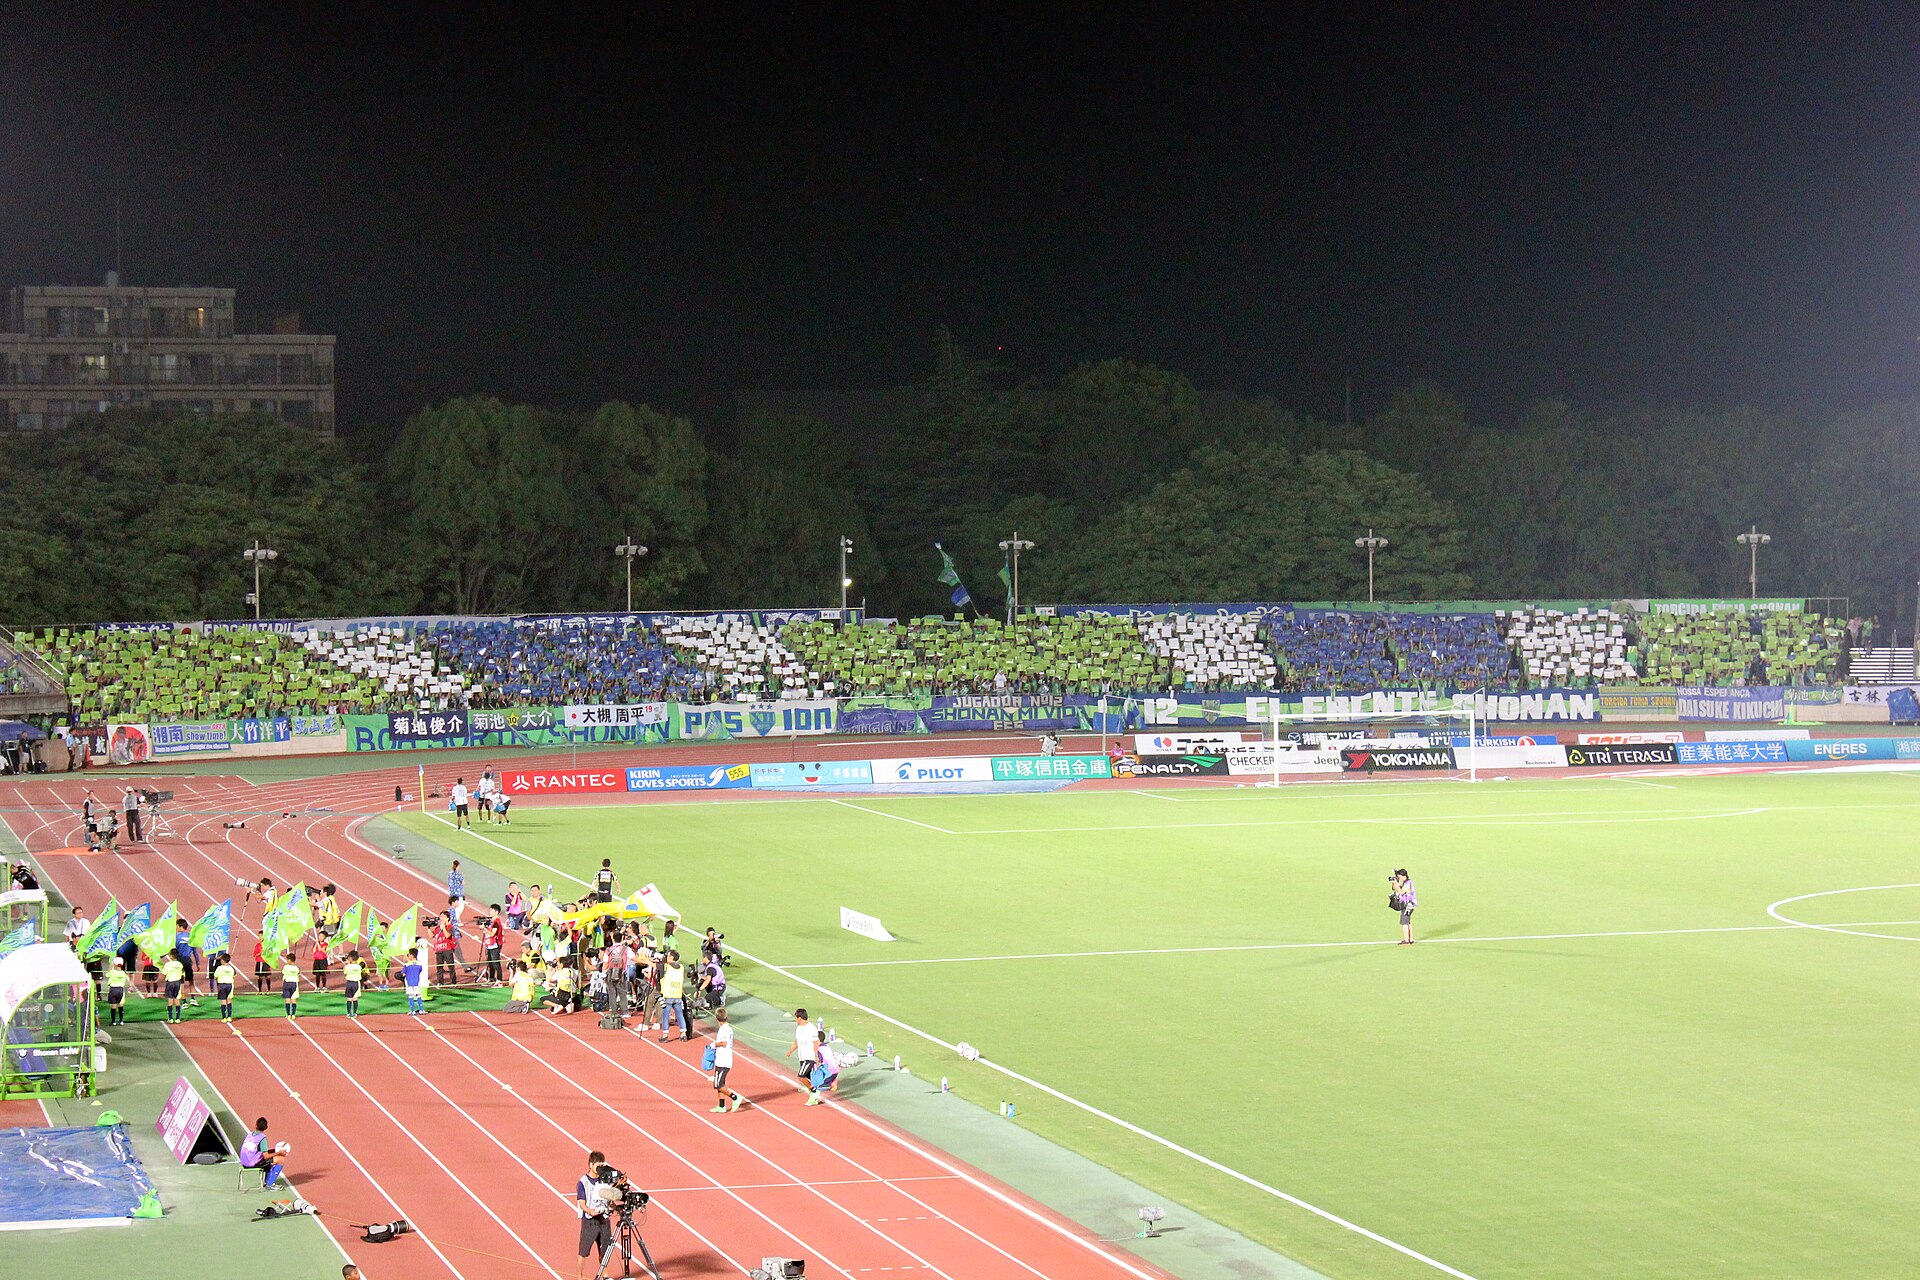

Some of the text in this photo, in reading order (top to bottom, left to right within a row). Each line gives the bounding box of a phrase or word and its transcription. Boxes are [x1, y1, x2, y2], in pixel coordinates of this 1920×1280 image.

[1679, 699, 1730, 718] DAISUKE
[231, 720, 289, 742] 大竹洋平
[394, 715, 463, 735] 菊地俊介
[153, 725, 184, 743] 湘南
[1679, 742, 1784, 761] 産業能率大学
[1814, 743, 1867, 755] ENERES
[1313, 757, 1340, 766] Jeep
[1371, 752, 1451, 766] YOKOHAMA
[629, 770, 660, 779] KIRIN
[917, 768, 964, 779] PILOT
[997, 759, 1108, 776] 平塚信用金庫
[533, 774, 616, 788] RANTEC
[631, 777, 707, 788] LOVES SPORTS
